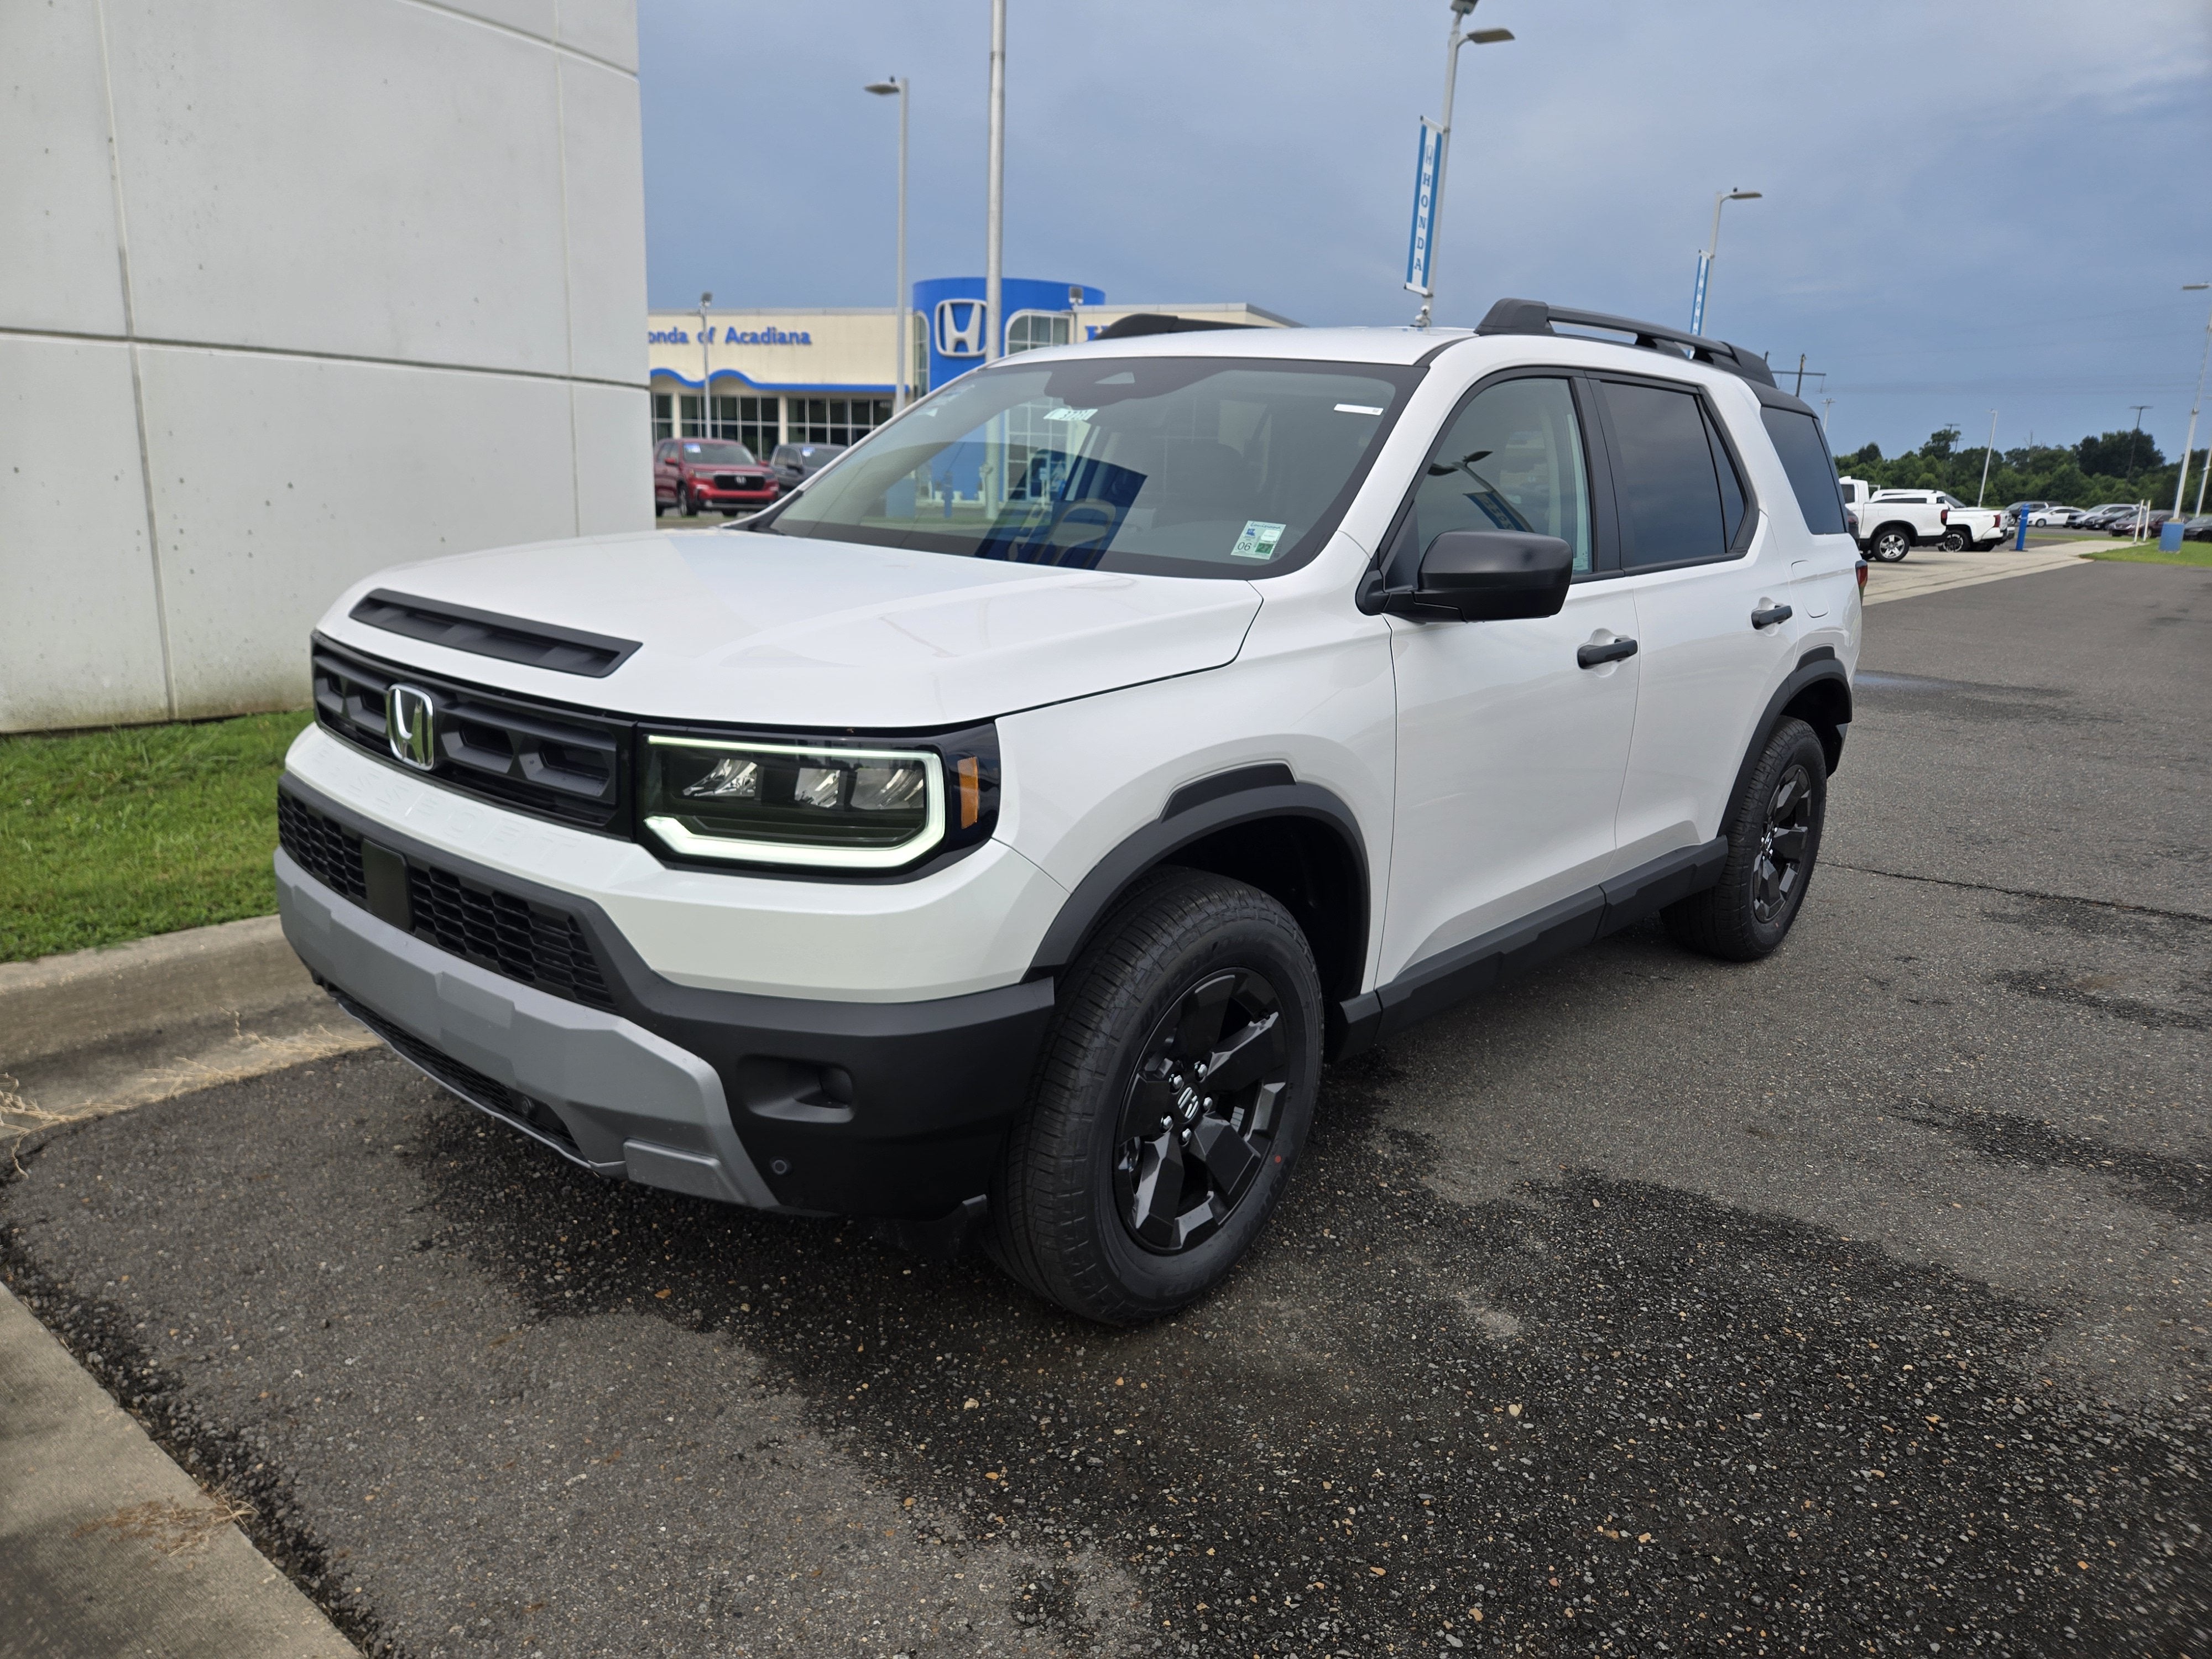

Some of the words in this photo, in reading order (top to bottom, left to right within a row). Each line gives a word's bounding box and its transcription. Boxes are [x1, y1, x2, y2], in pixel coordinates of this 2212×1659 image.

[1414, 173, 1431, 271] HONDA
[648, 326, 690, 344] onda
[726, 326, 812, 345] Acadiana
[1237, 541, 1252, 551] 06
[1256, 544, 1271, 552] 27
